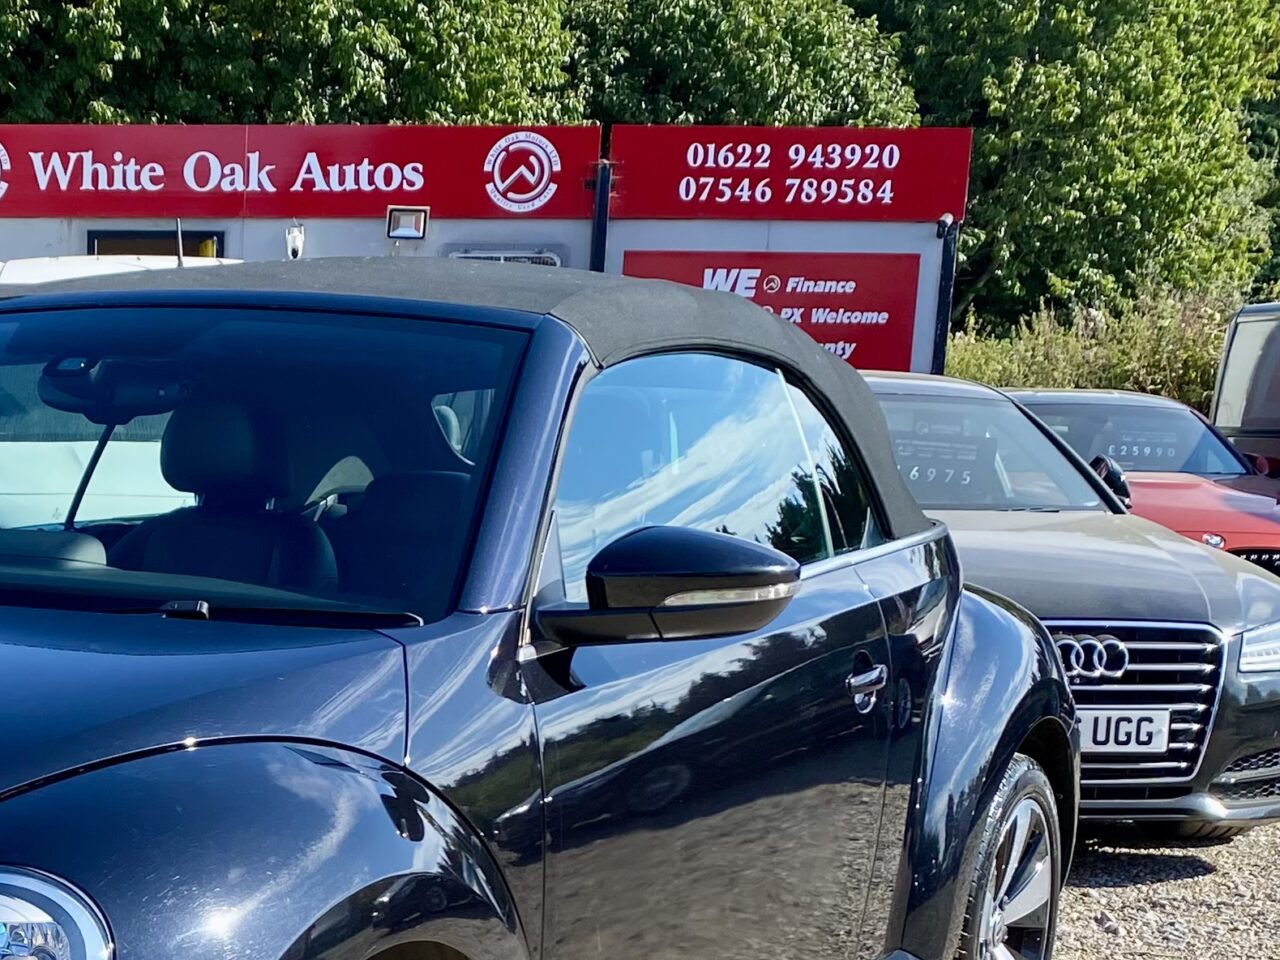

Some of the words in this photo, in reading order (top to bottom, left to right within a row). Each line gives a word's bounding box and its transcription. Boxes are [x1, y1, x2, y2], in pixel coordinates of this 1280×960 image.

[686, 142, 771, 168] 01622
[788, 143, 901, 169] 943920
[29, 150, 165, 192] White
[182, 150, 277, 192] Oak
[289, 152, 425, 192] Autos
[678, 176, 772, 202] 07546
[784, 178, 894, 204] 789584
[702, 268, 761, 298] WE
[785, 276, 856, 295] Finance
[811, 308, 889, 324] Welcome
[1107, 444, 1176, 458] £25990
[897, 464, 972, 485] 6975
[1091, 716, 1155, 746] UGG
